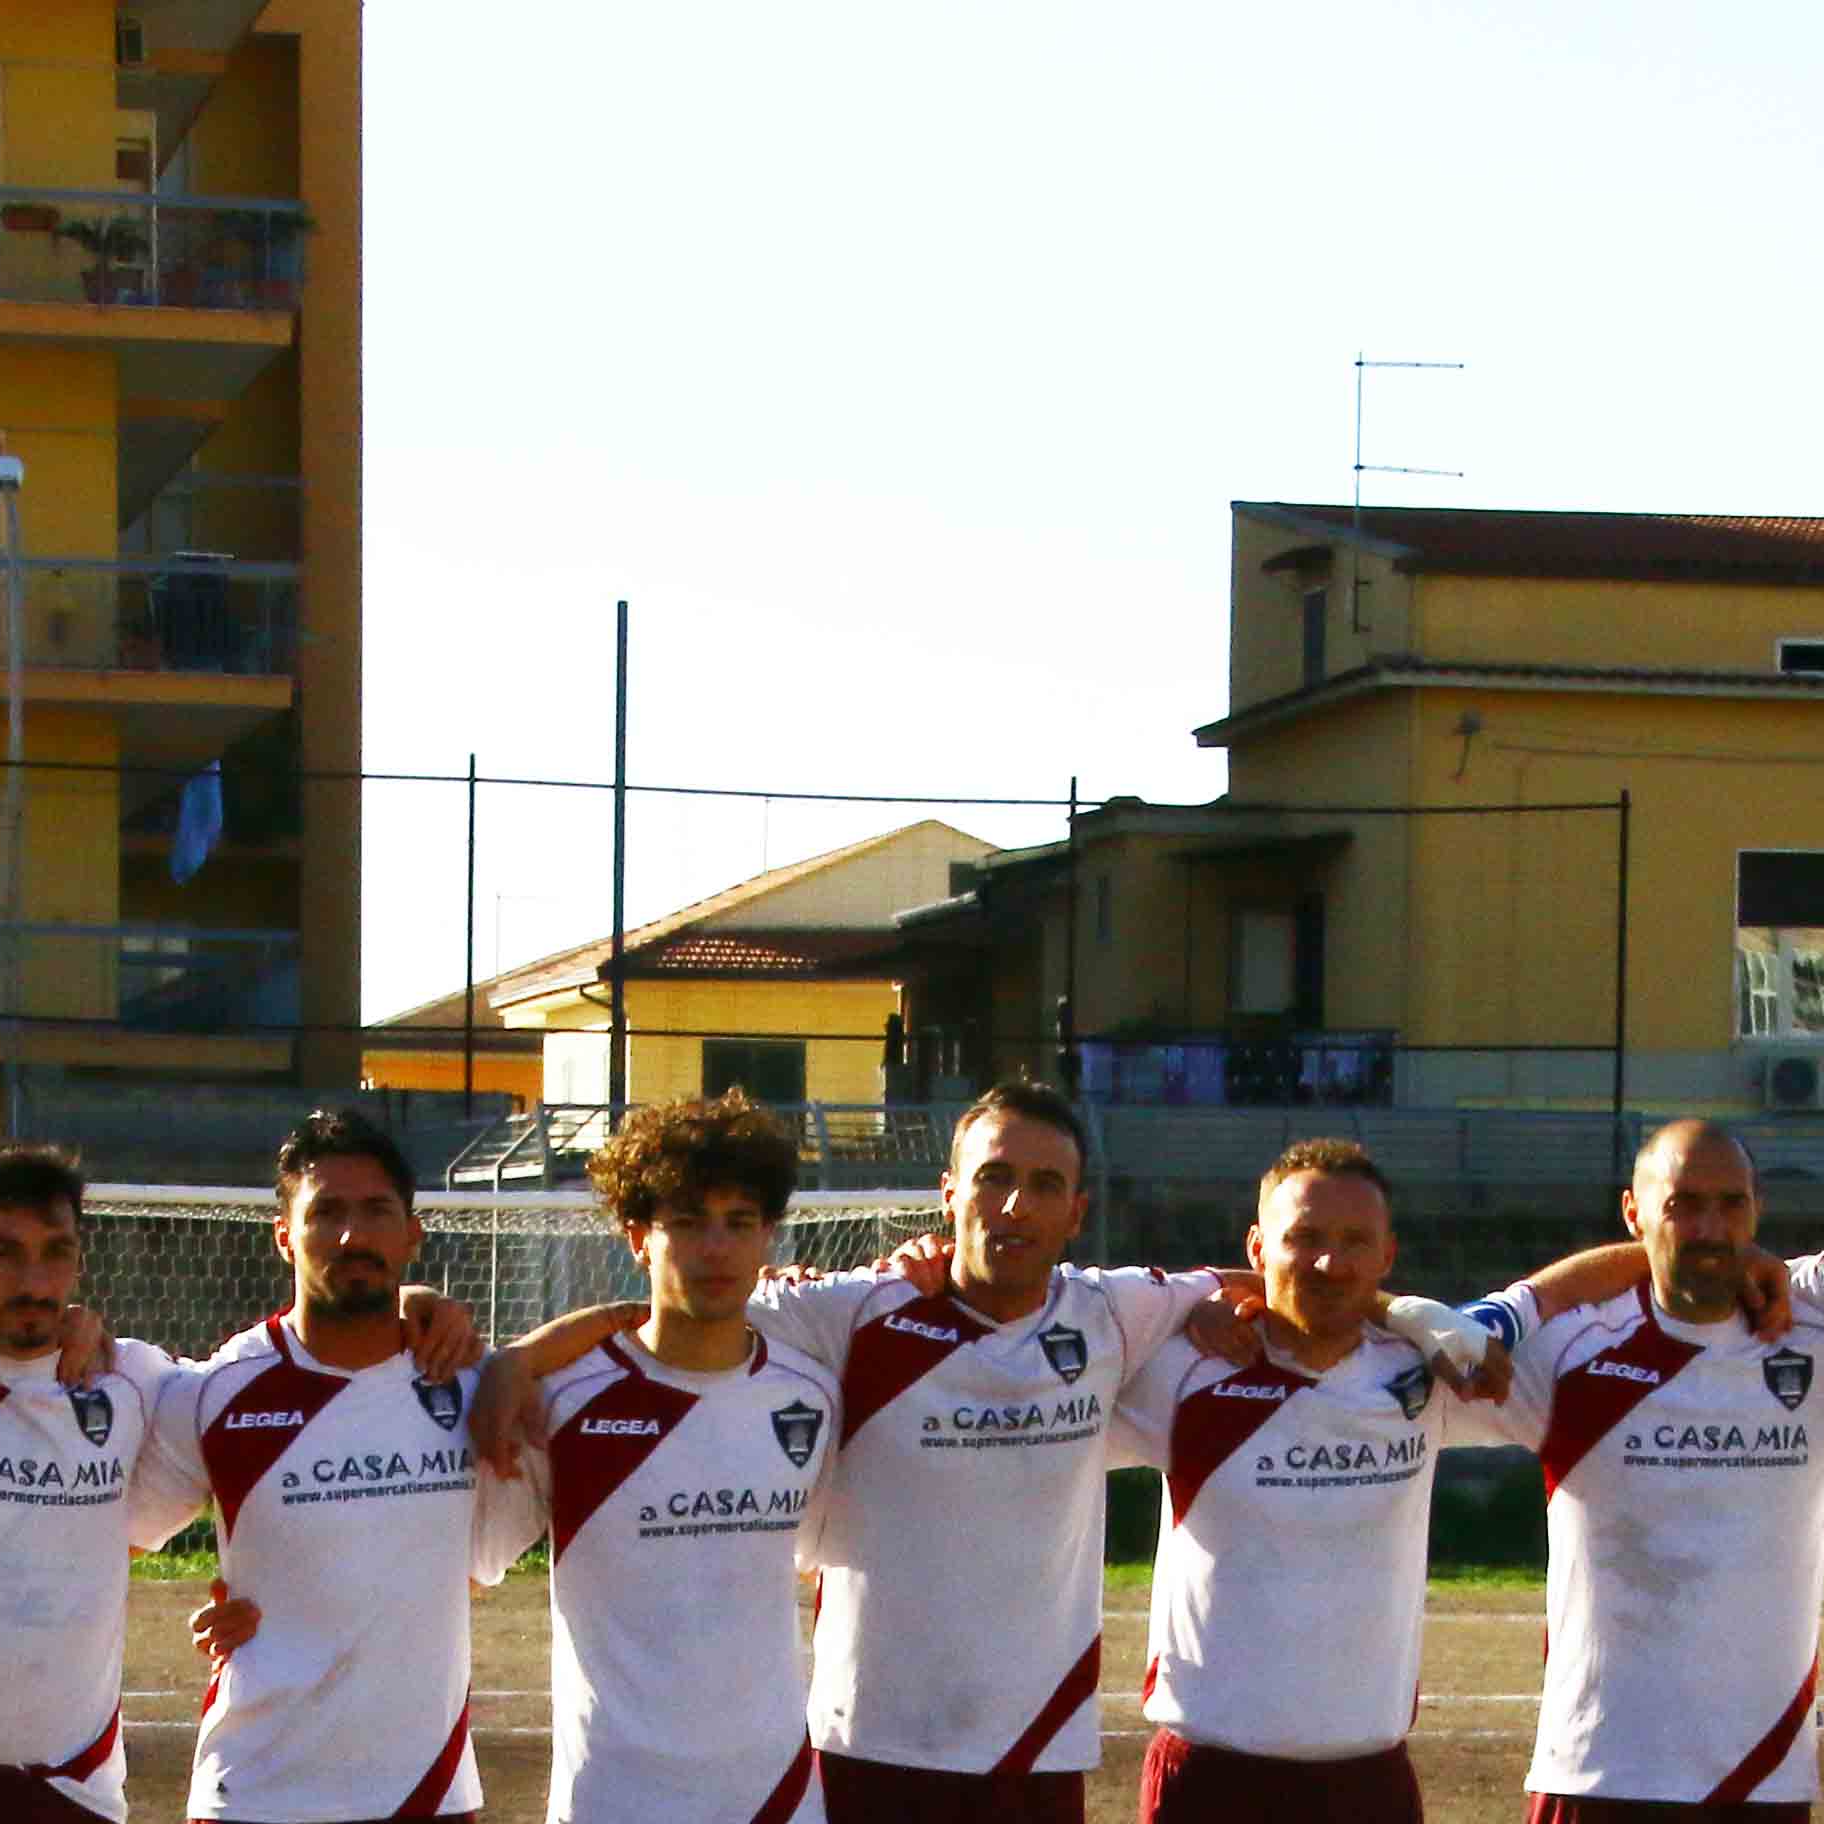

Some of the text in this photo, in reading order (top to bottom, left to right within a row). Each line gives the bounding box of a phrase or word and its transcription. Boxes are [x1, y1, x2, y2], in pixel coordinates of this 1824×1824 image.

[883, 1313, 959, 1343] LEGEA
[1587, 1360, 1660, 1384] LEGEA
[1213, 1383, 1287, 1400] LEGEA
[226, 1409, 305, 1430] LEGEA
[922, 1394, 1101, 1432] a CASA MIA
[580, 1418, 660, 1436] LEGEA
[1625, 1424, 1808, 1451] a CASA MIA
[282, 1471, 300, 1488] a
[312, 1452, 411, 1483] CASA
[1256, 1454, 1274, 1471] a
[1285, 1444, 1377, 1471] CASA
[71, 1457, 124, 1489] MIA
[640, 1505, 657, 1521] a
[668, 1489, 759, 1517] CASA
